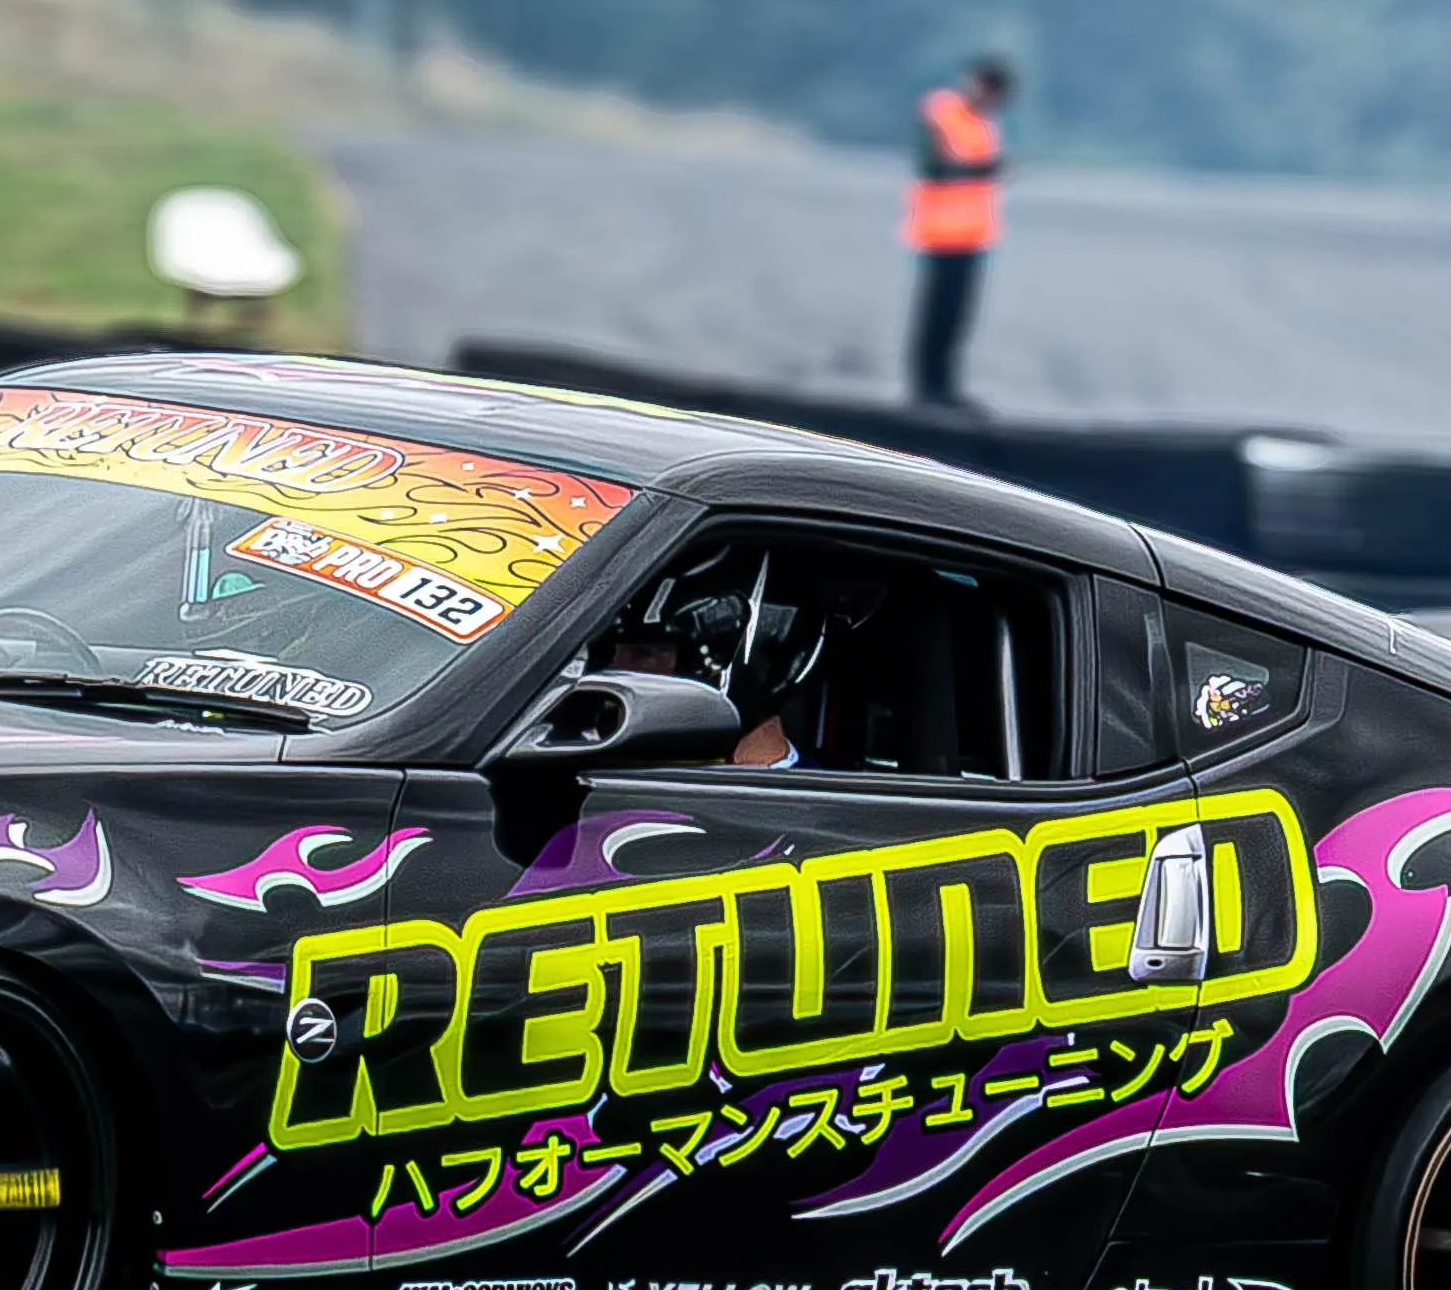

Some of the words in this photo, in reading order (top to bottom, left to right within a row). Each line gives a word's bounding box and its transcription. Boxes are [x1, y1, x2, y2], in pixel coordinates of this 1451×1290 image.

[311, 546, 405, 590] PRO
[398, 577, 485, 626] 132
[132, 656, 374, 720] RETUNED
[269, 788, 1319, 1151] RETUNED
